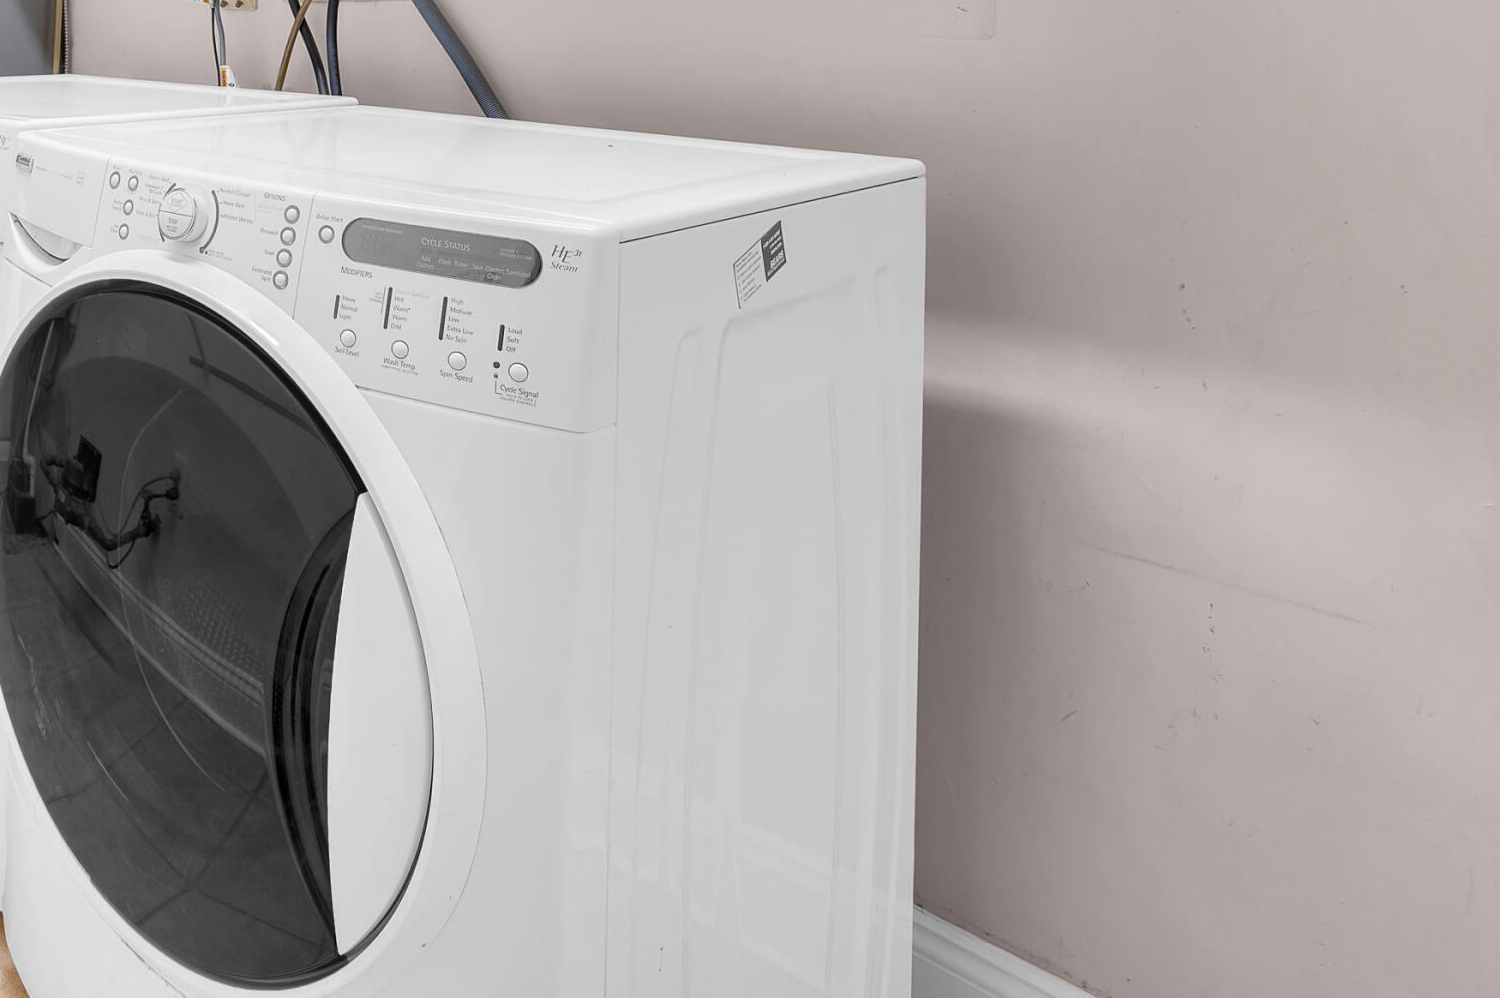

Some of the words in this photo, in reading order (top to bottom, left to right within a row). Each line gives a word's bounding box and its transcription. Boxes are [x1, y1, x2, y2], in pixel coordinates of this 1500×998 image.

[421, 236, 442, 248] CYCLE
[443, 240, 470, 252] STATUS
[340, 266, 373, 278] MODIFIERS
[550, 261, 578, 273] Steam
[448, 315, 460, 323] Low
[447, 325, 461, 333] Extra
[508, 326, 523, 335] Loud
[383, 357, 399, 366] Wash
[400, 360, 416, 371] Temp
[439, 369, 453, 378] Spin
[454, 372, 474, 383] Speed
[500, 384, 517, 394] Cycle
[518, 387, 539, 398] Signal
